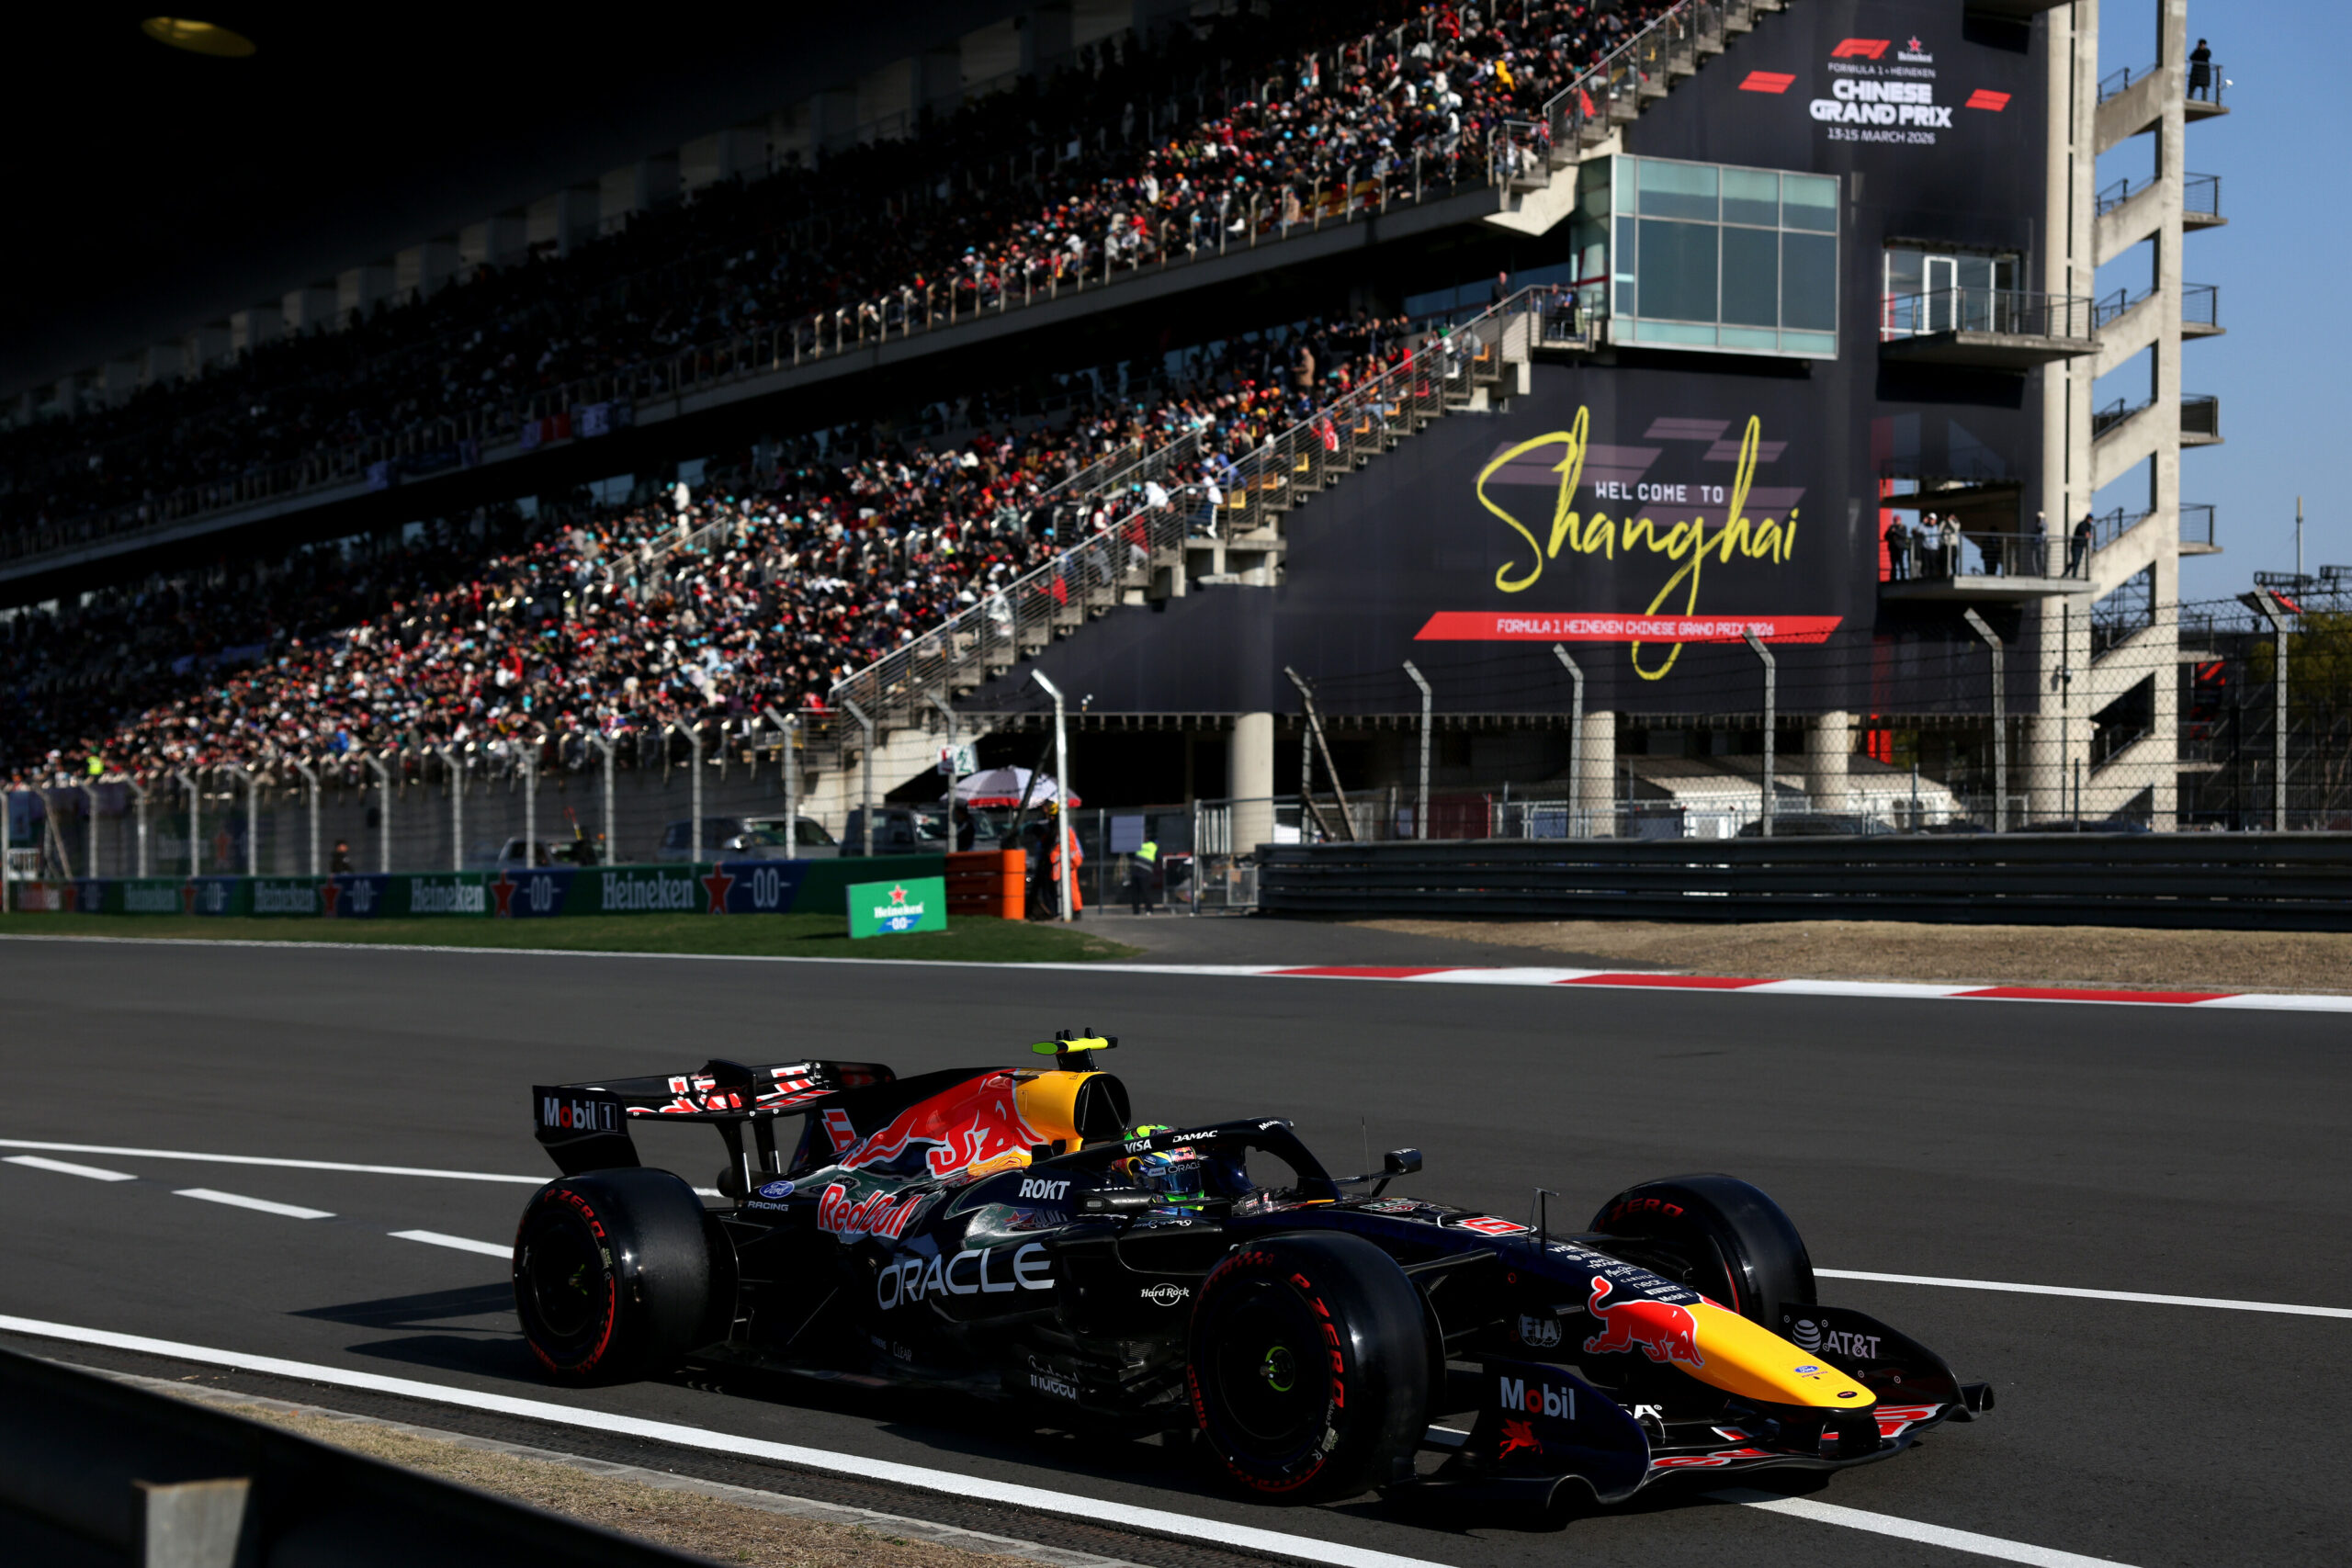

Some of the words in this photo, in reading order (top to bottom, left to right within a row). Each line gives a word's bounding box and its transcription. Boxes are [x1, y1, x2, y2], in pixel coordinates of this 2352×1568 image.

[1827, 62, 1875, 75] FORMULA
[1832, 79, 1932, 104] CHINESE
[1809, 98, 1896, 125] GRAND
[1899, 104, 1952, 128] PRIX
[1861, 129, 1905, 143] MARCH
[1701, 485, 1724, 503] TO
[1476, 405, 1799, 681] Shanghai
[1497, 618, 1550, 633] FORMULA
[1564, 619, 1623, 634] HEINEKEN
[1625, 620, 1677, 635] CHINESE
[1679, 622, 1713, 635] GRAND
[1716, 622, 1744, 636] PRIX
[410, 877, 486, 912] Heineken
[601, 871, 695, 911] Heineken
[874, 902, 924, 919] Heineken
[544, 1098, 595, 1130] Mobil
[1124, 1139, 1152, 1154] VISA
[1172, 1130, 1218, 1143] DAMAC
[1019, 1179, 1070, 1201] ROKT
[748, 1201, 789, 1212] RACING
[877, 1242, 1055, 1310] ORACLE
[1141, 1288, 1164, 1298] Hard
[1167, 1287, 1190, 1298] Rock
[1308, 1297, 1343, 1408] ZERO
[1826, 1330, 1881, 1359] AT&T
[1499, 1376, 1576, 1421] Mobil
